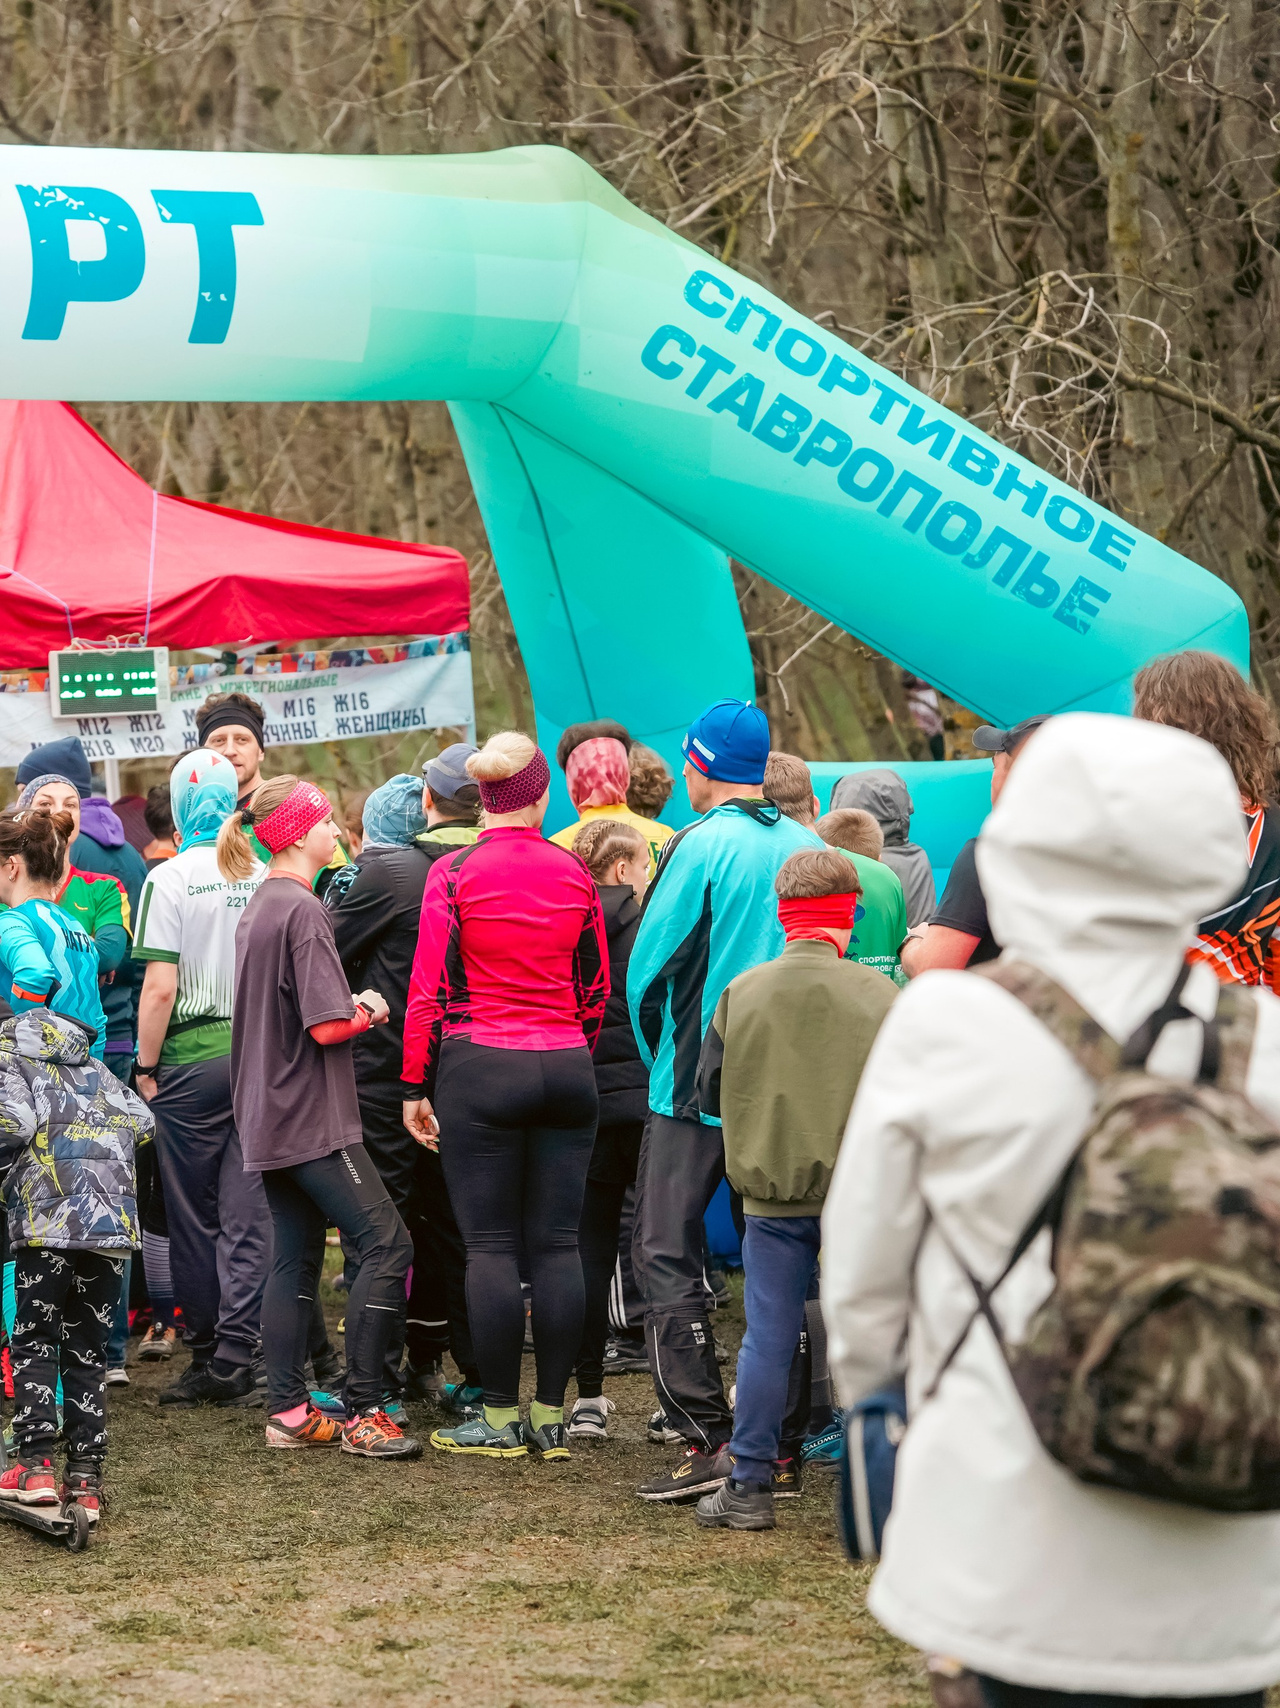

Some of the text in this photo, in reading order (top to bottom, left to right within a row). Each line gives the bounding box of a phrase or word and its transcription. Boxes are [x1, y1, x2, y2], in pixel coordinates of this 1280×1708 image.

[640, 324, 1113, 636] СТАВРОПОЛЬЕ
[683, 269, 1137, 573] СПОРТИВНОЕ
[76, 717, 112, 736] М12
[127, 712, 166, 733] Ж12
[283, 697, 317, 719] М16
[333, 691, 370, 713] Ж16
[129, 735, 165, 754] М20
[335, 706, 428, 736] ЖЕНЩИНЫ
